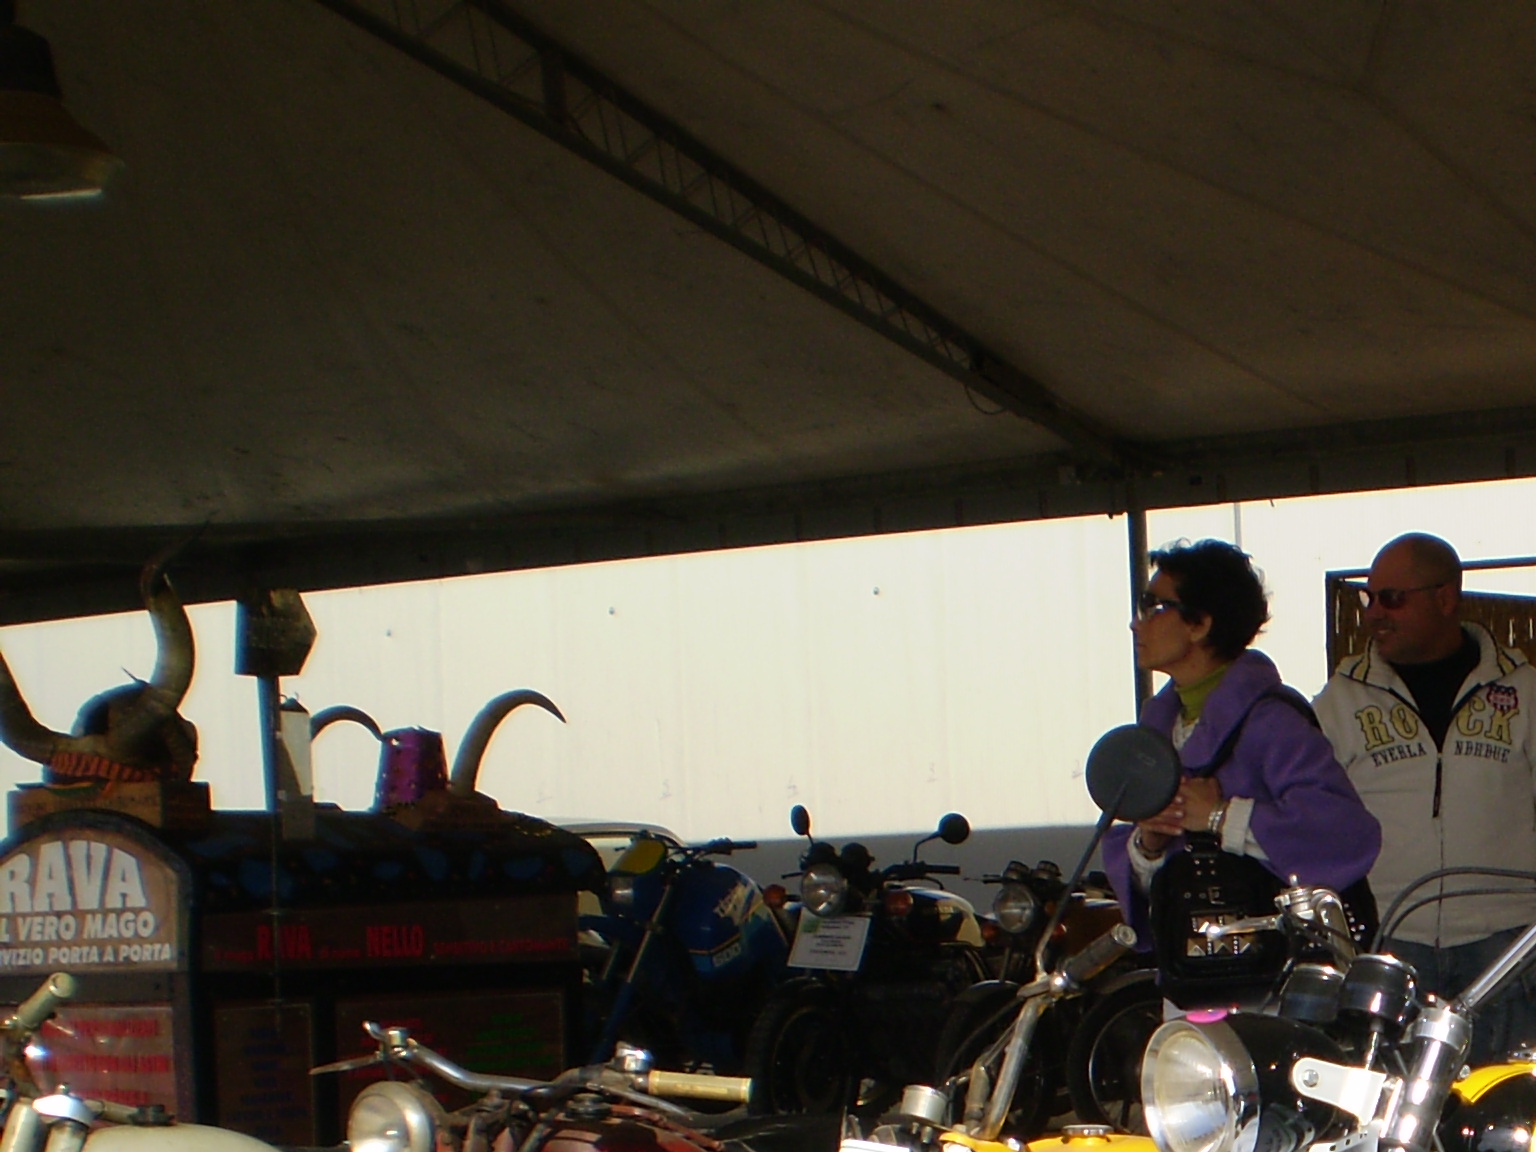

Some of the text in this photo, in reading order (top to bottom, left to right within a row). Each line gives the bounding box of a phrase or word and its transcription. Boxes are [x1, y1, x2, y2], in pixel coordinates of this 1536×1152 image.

[17, 914, 77, 942] VERO
[83, 911, 156, 940] MAGO
[49, 948, 99, 965] PORTA
[103, 947, 115, 963] A
[119, 943, 172, 962] PORTA
